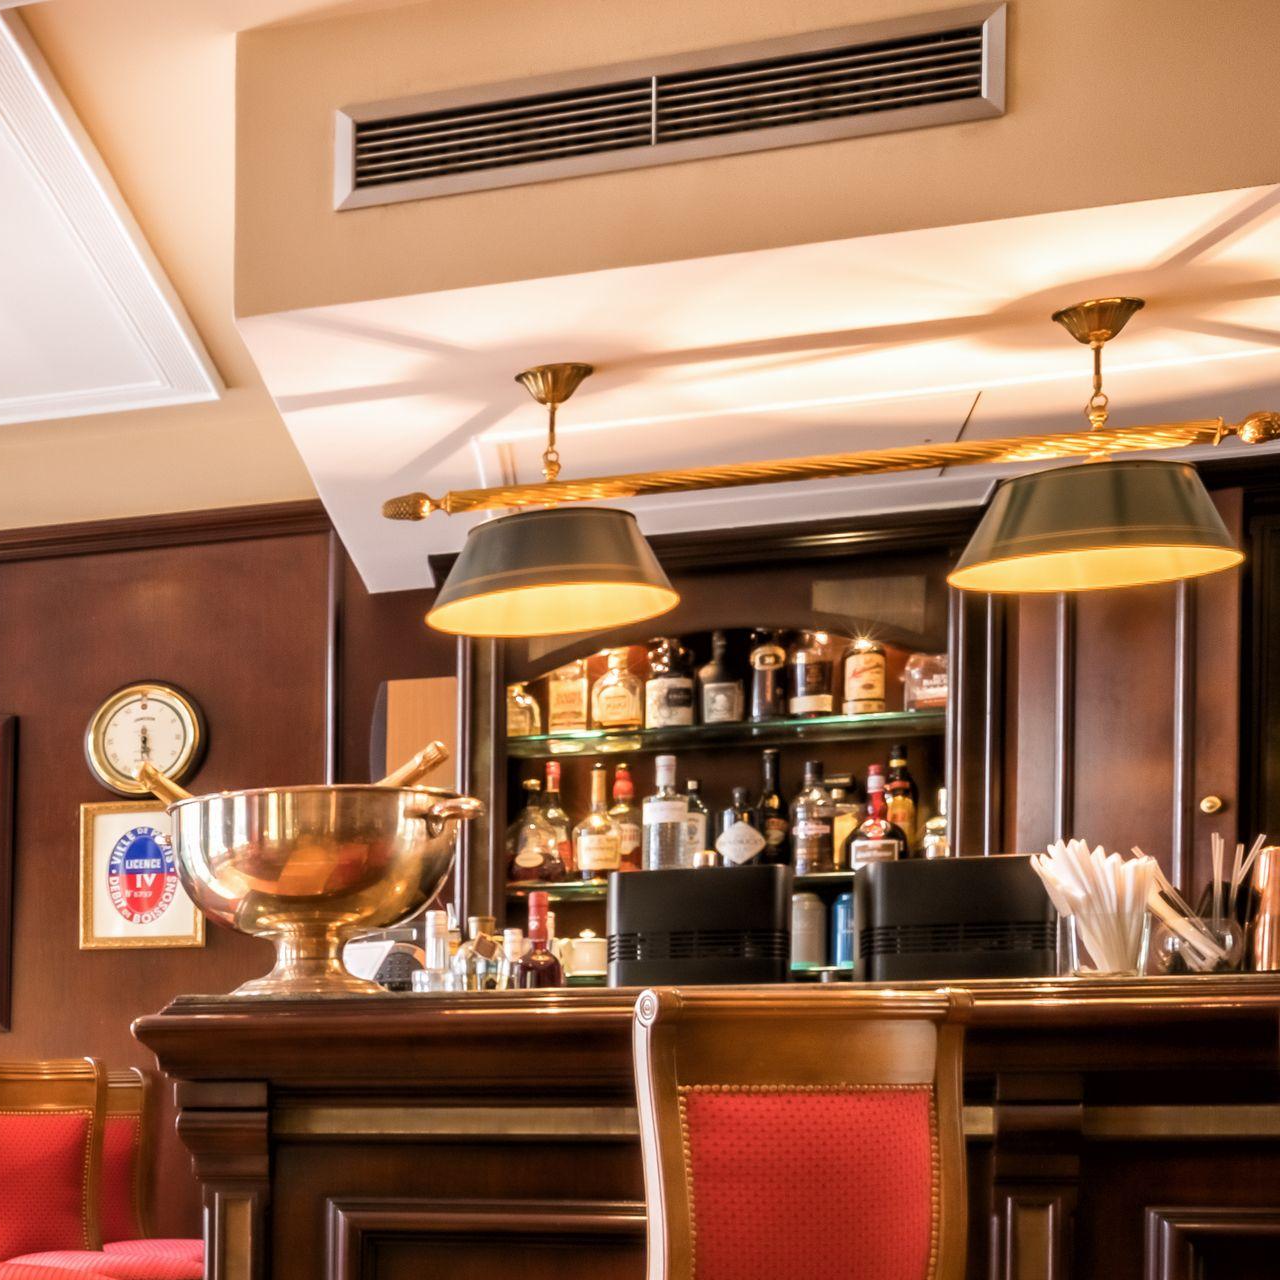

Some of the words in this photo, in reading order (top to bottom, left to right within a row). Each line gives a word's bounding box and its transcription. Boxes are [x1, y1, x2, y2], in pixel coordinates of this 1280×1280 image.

[111, 832, 136, 864] VILLE
[125, 859, 161, 869] LICENCE
[135, 874, 157, 888] IV
[133, 876, 177, 923] BOISSONS
